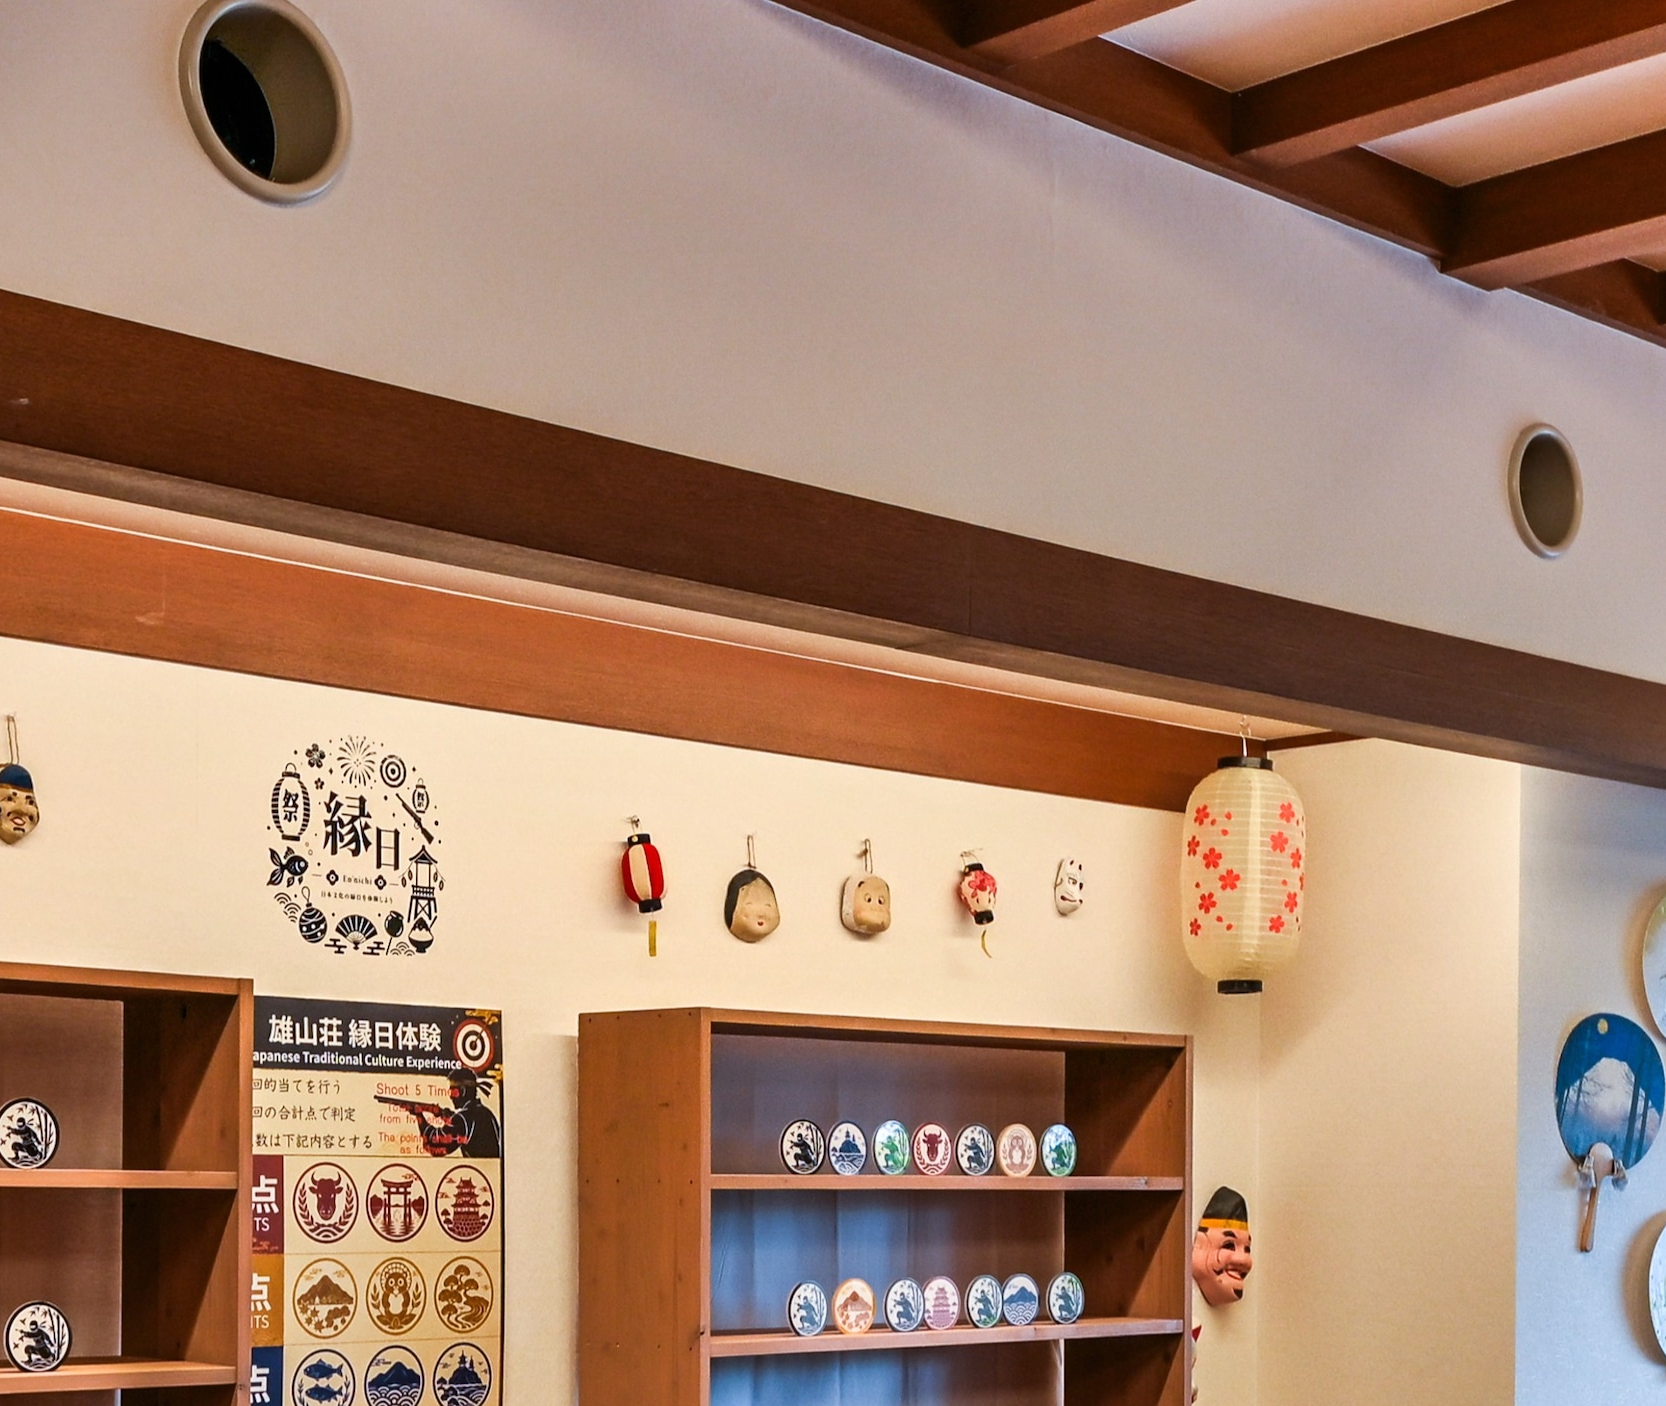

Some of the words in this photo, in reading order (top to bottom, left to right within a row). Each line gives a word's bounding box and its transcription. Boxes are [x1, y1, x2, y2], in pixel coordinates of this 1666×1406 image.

[282, 788, 299, 823] 祭
[323, 790, 400, 871] 縁日
[269, 1014, 343, 1048] 雄山荘
[348, 1020, 442, 1052] 縁日体験
[252, 1052, 301, 1066] apanese
[302, 1052, 364, 1067] Traditional
[365, 1053, 404, 1067] Culture
[406, 1055, 462, 1071] Experience
[376, 1082, 409, 1096] Shoot
[415, 1084, 422, 1096] 5
[379, 1114, 401, 1123] from
[252, 1133, 372, 1149] 数は下記内容とする
[378, 1132, 395, 1142] The
[252, 1175, 279, 1214] 点
